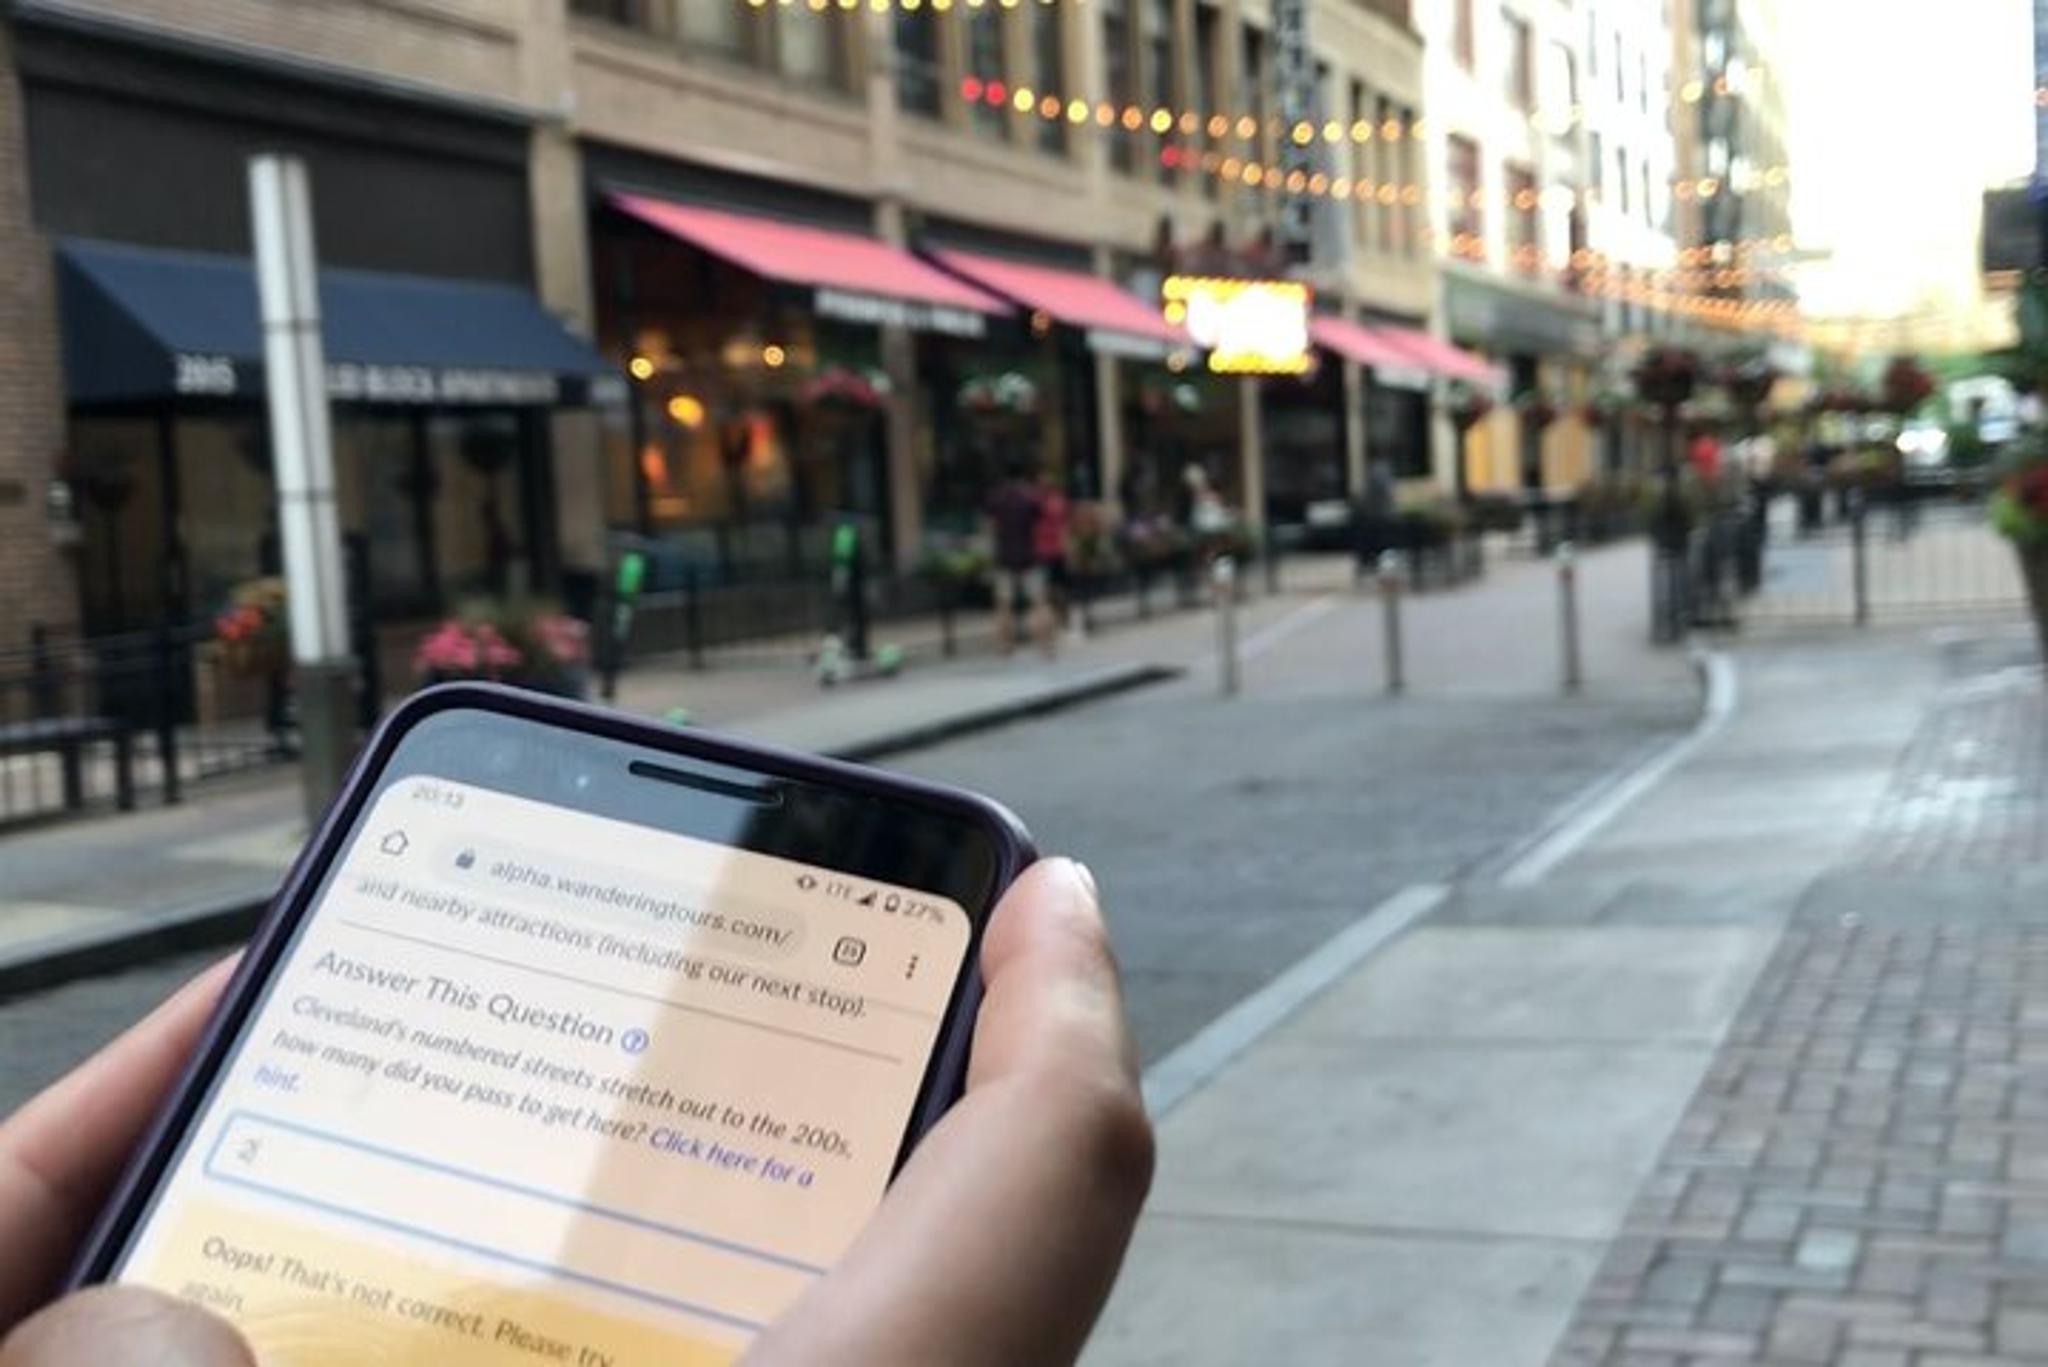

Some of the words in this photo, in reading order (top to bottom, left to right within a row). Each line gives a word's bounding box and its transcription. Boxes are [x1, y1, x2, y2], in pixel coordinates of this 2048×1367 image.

[400, 888, 476, 923] nearby
[477, 907, 594, 952] attractions
[598, 934, 705, 980] (including
[708, 965, 749, 986] our
[750, 975, 803, 1001] next
[490, 858, 793, 946] alpha.wanderingtours.com/
[903, 901, 946, 925] 27%
[312, 950, 421, 994] Answer
[425, 976, 482, 1013] This
[486, 993, 614, 1047] Question
[253, 1064, 301, 1094] hint.
[272, 1028, 321, 1052] how
[321, 1044, 383, 1075] many
[383, 1060, 423, 1084] did
[420, 1072, 464, 1098] you
[460, 1085, 515, 1111] pass
[516, 1093, 543, 1118] to
[540, 1104, 583, 1129] get
[585, 1109, 650, 1143] here?
[649, 1124, 703, 1160] Click
[705, 1141, 760, 1172] here
[760, 1154, 795, 1184] for
[797, 1168, 815, 1188] a
[291, 996, 407, 1041] Cleveland's
[409, 1028, 523, 1071] numbered
[522, 1056, 594, 1093] streets
[598, 1073, 674, 1113] stretch
[678, 1098, 718, 1122] out
[720, 1105, 746, 1129] to
[748, 1112, 789, 1139] the
[202, 1235, 275, 1274] Oops!
[279, 1255, 348, 1295] That's
[350, 1280, 398, 1310] not
[397, 1294, 486, 1342] correct.
[494, 1317, 574, 1359] Please
